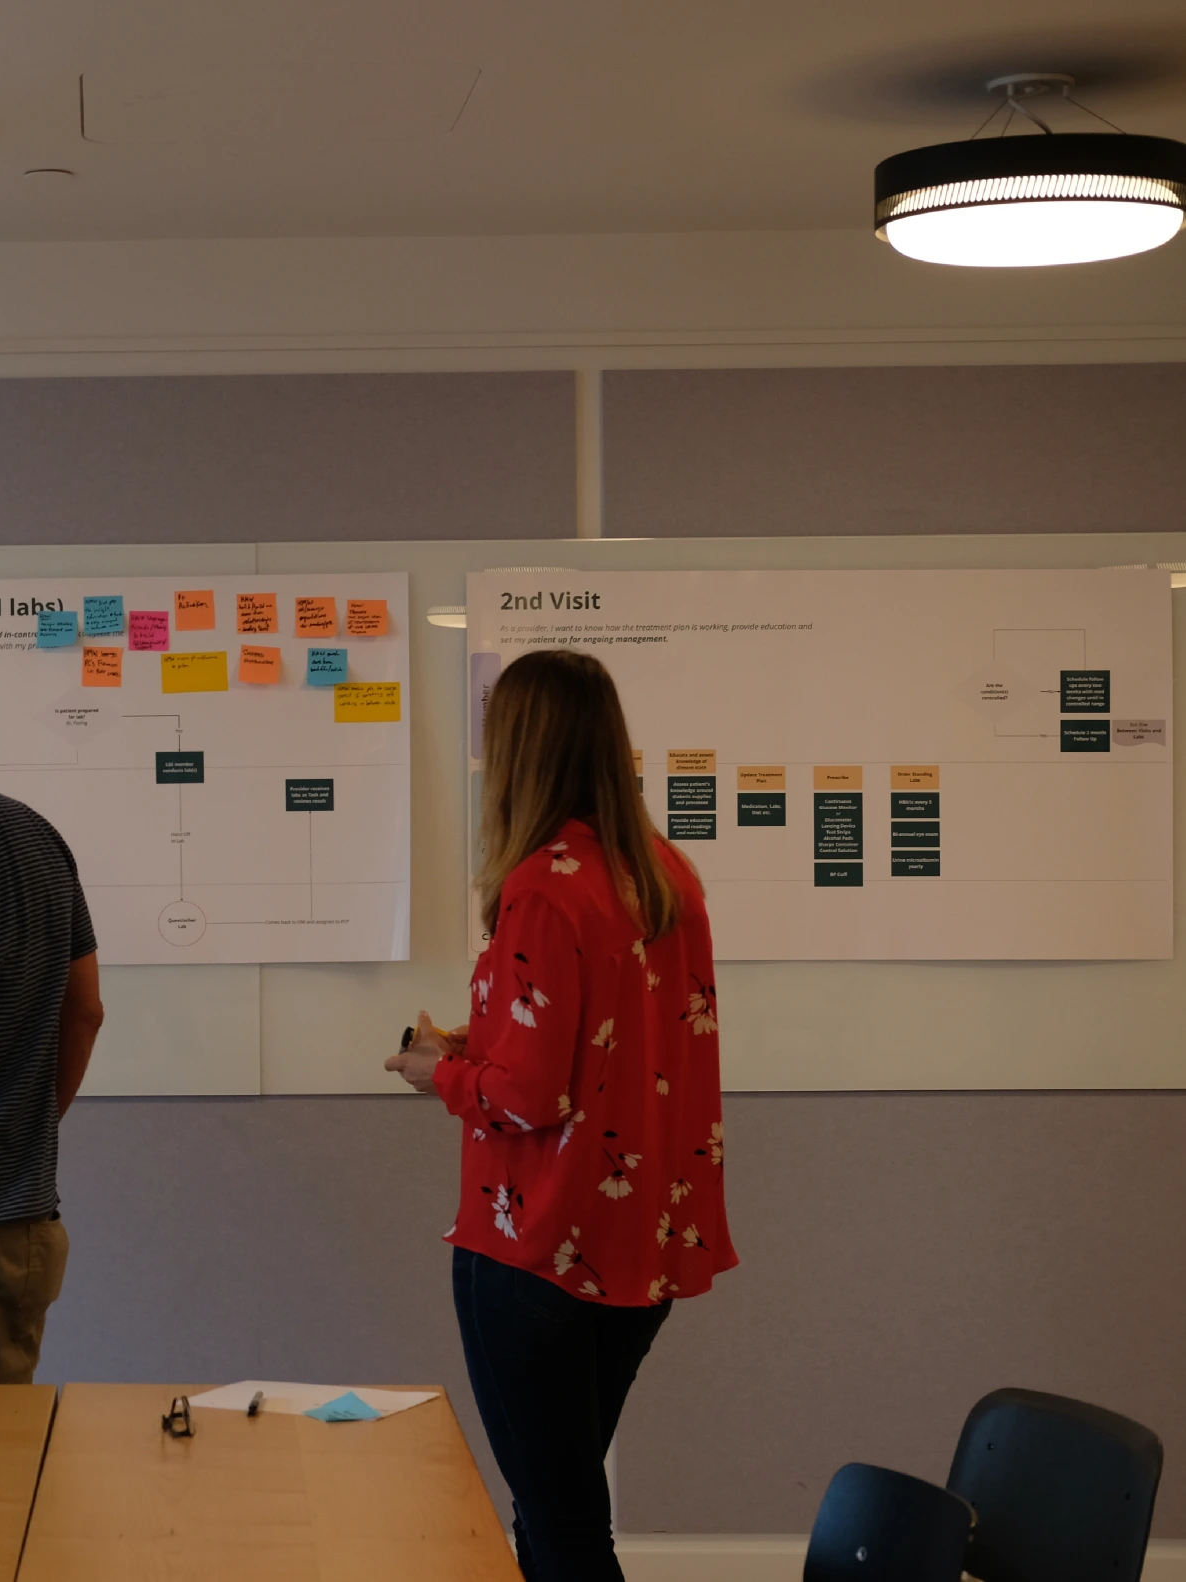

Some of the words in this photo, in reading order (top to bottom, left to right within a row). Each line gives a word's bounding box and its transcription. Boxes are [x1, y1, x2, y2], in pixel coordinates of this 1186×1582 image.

[500, 591, 543, 610] 2nd
[549, 590, 601, 610] Visit
[673, 624, 690, 633] plan
[692, 623, 698, 631] is
[699, 623, 728, 632] working,
[731, 623, 759, 632] provide
[760, 623, 796, 631] education
[798, 622, 813, 630] and
[527, 636, 556, 644] patient
[568, 635, 581, 644] for
[582, 636, 614, 644] ongoing
[615, 636, 669, 644] management.
